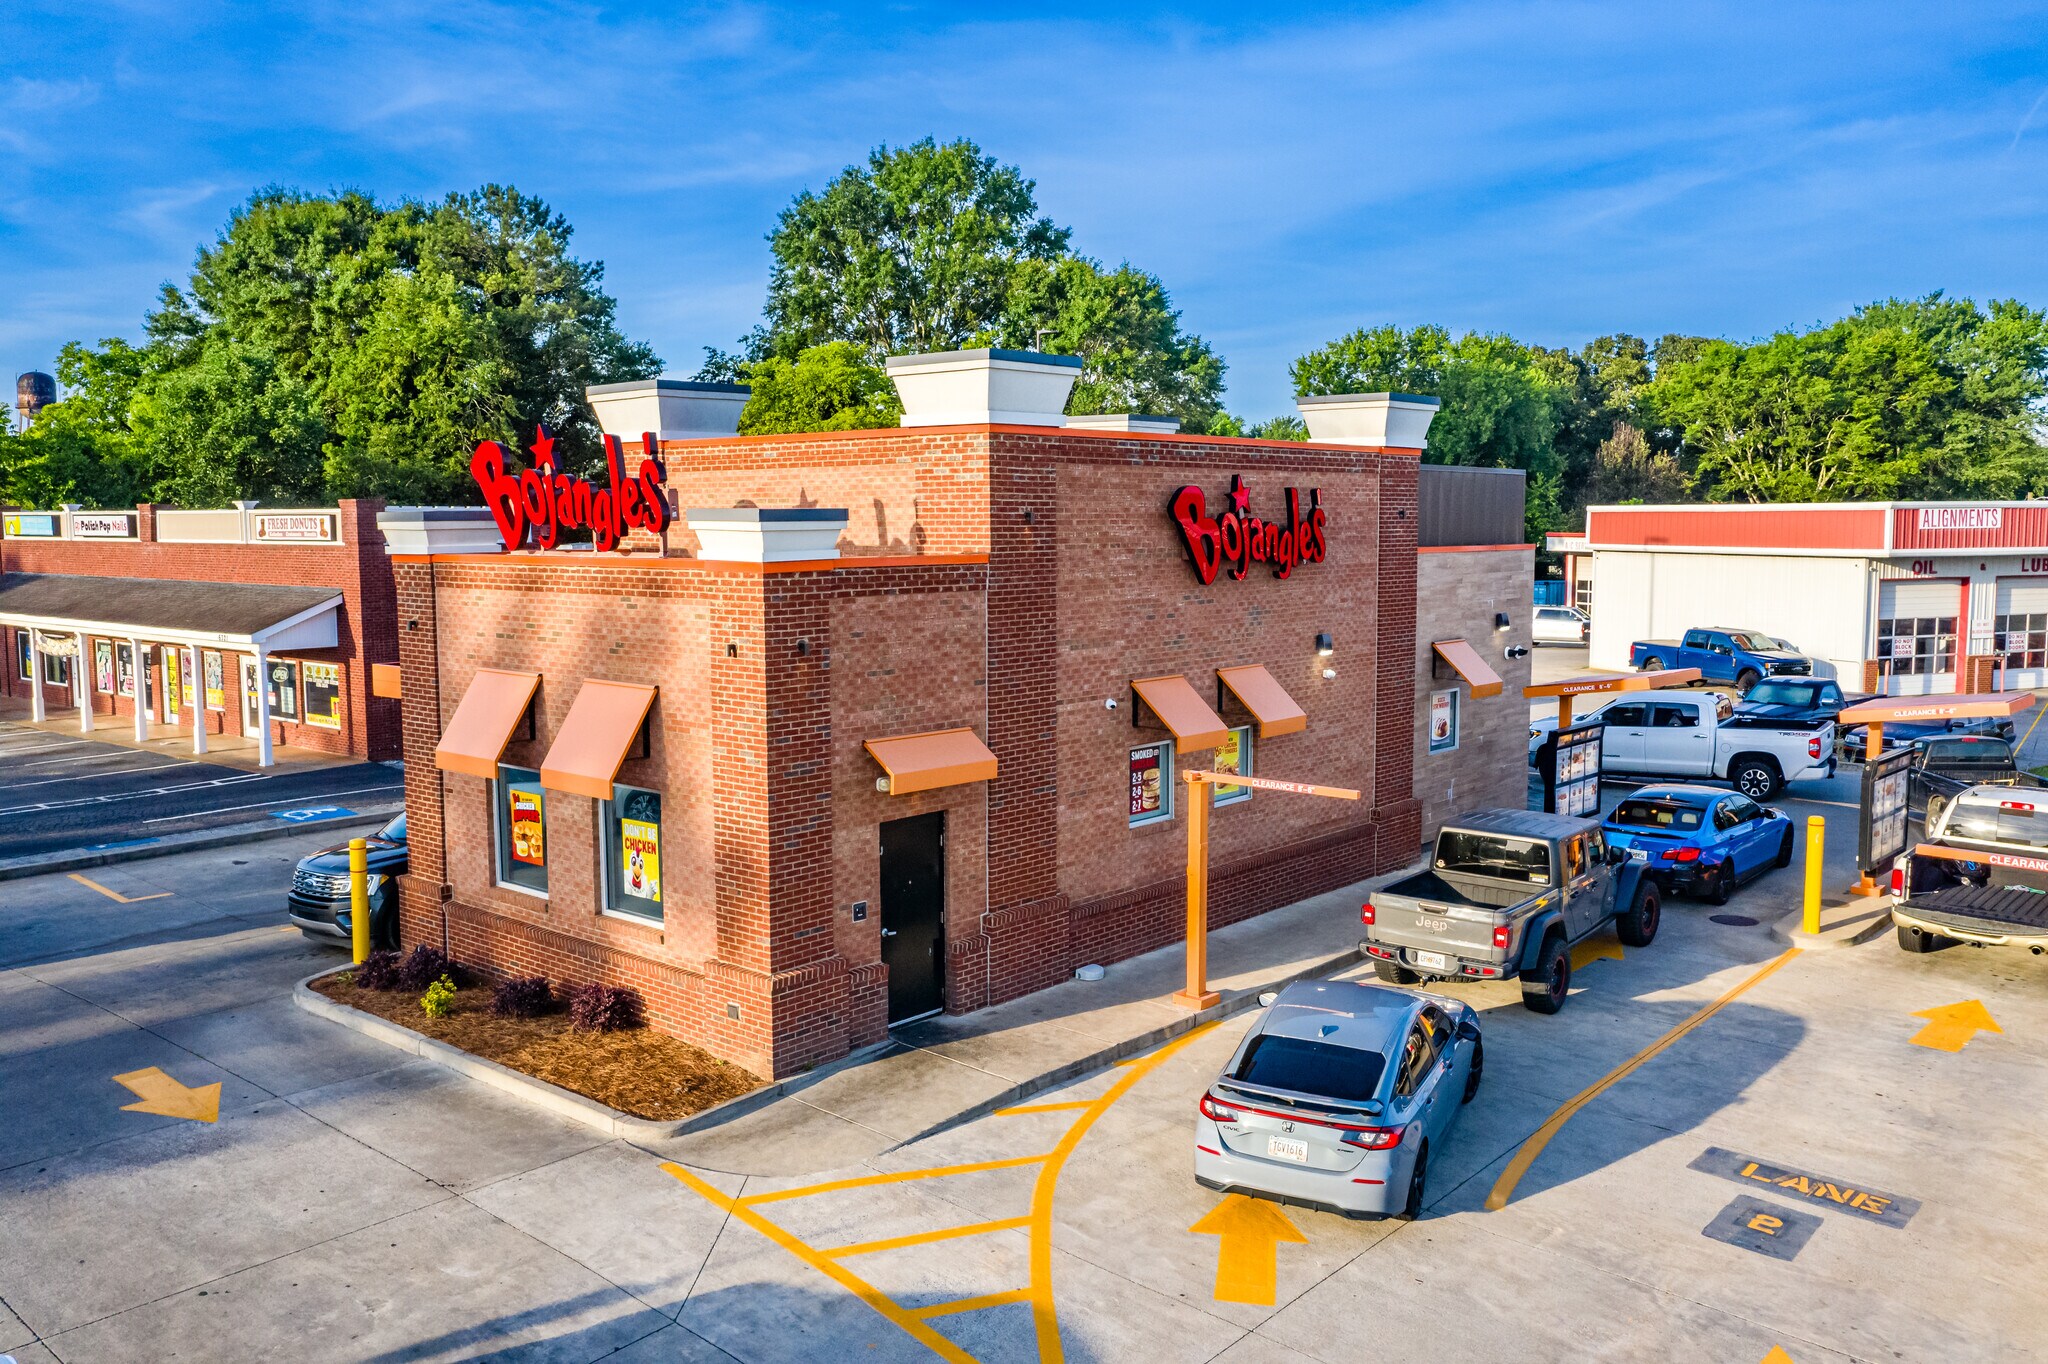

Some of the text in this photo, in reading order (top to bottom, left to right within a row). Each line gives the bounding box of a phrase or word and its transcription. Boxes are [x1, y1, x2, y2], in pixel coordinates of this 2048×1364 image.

[267, 517, 318, 530] FRESH DONUTS
[1922, 508, 1998, 528] ALIGNMENTS
[80, 520, 98, 531] Polish
[99, 520, 111, 534] Pop
[112, 521, 127, 532] Nails
[1912, 560, 1938, 575] OIL
[1980, 563, 1986, 571] &
[1563, 685, 1595, 693] CLEARANCE
[1894, 709, 1936, 717] CLEARANCE
[1131, 748, 1153, 761] SMOKED
[1252, 779, 1295, 791] CLEARANCE
[624, 823, 656, 840] DON'T BE
[625, 837, 657, 855] CHICKEN
[1415, 915, 1448, 932] Jeep
[1223, 1125, 1240, 1133] CIVIC
[1273, 1141, 1304, 1157] TGV1616
[1740, 1162, 1891, 1215] LANE
[1747, 1213, 1784, 1236] 2
